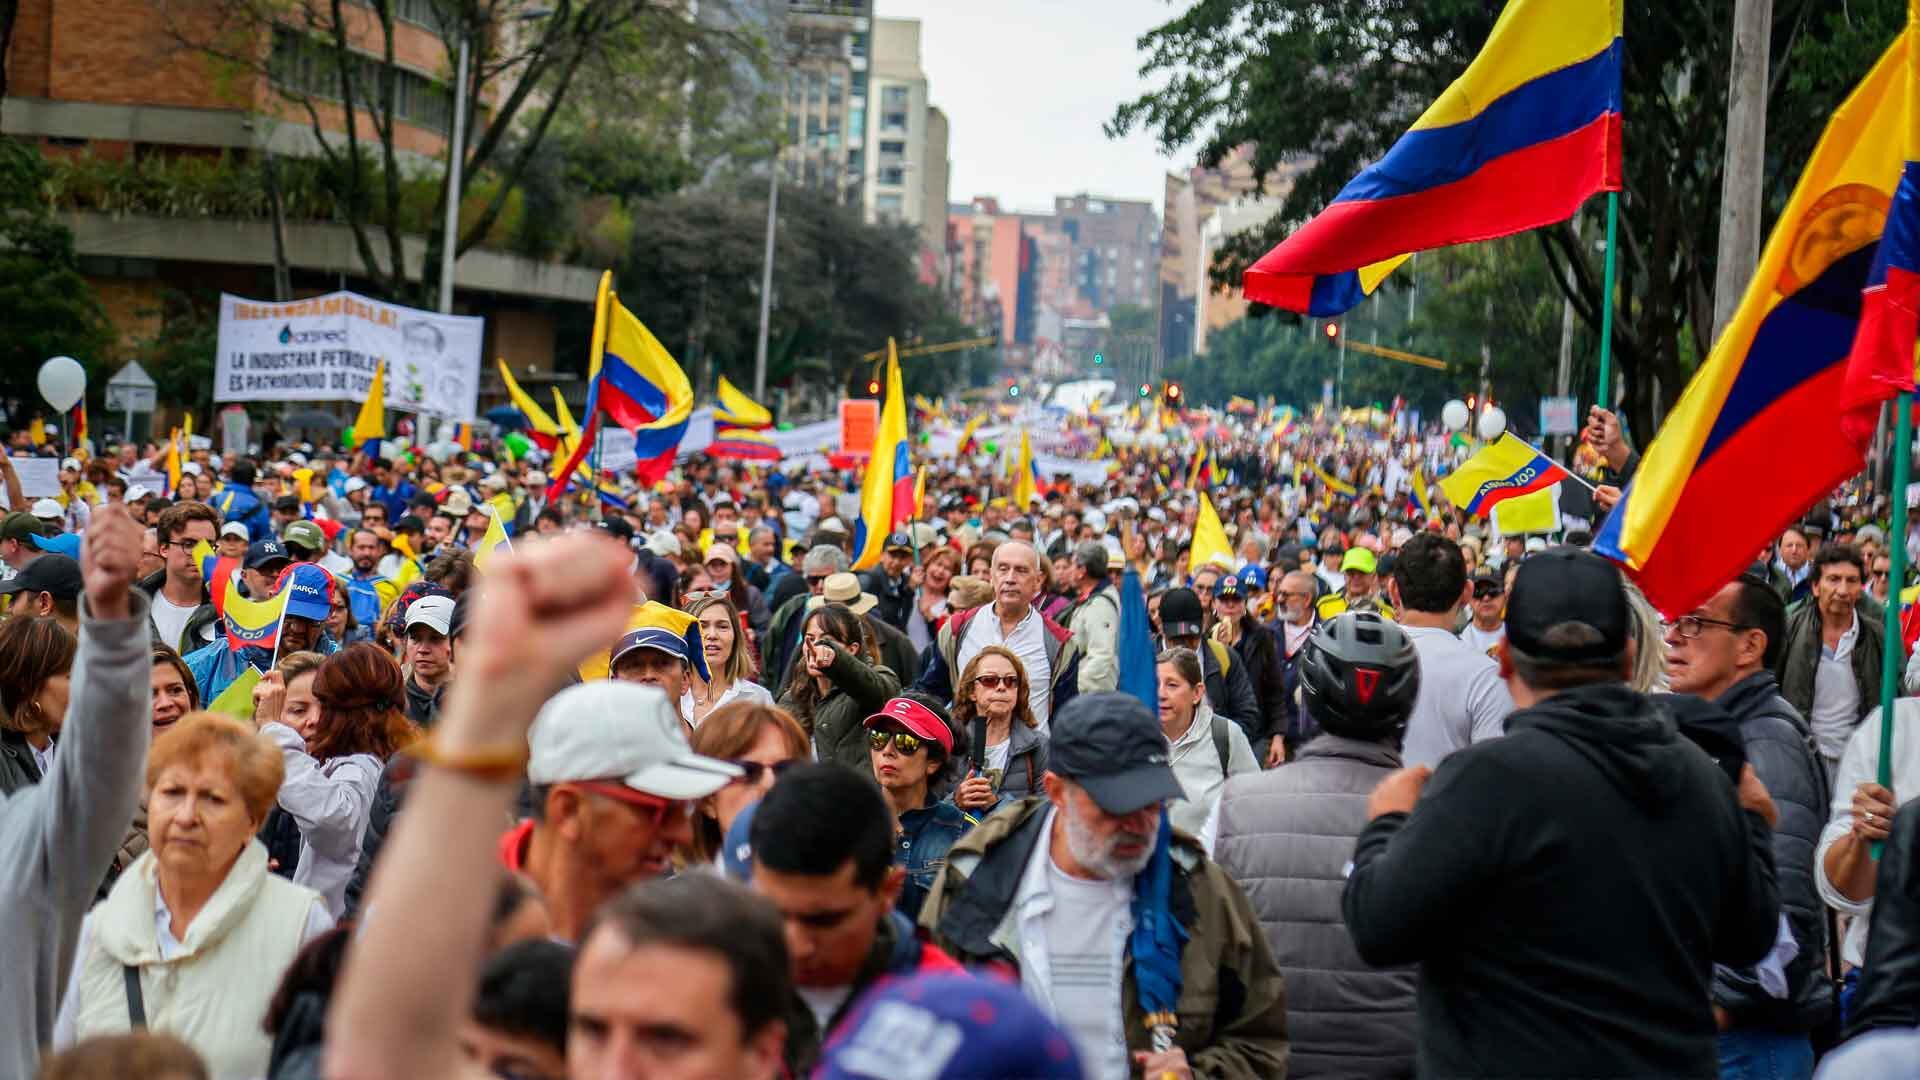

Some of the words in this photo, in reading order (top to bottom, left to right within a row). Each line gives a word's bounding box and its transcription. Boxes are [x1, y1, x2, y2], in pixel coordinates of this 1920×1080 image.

[231, 352, 244, 369] LA
[249, 350, 316, 369] INDUSTRIA
[229, 374, 243, 391] ES
[247, 372, 326, 391] PATRIMONIO
[331, 372, 348, 390] DE
